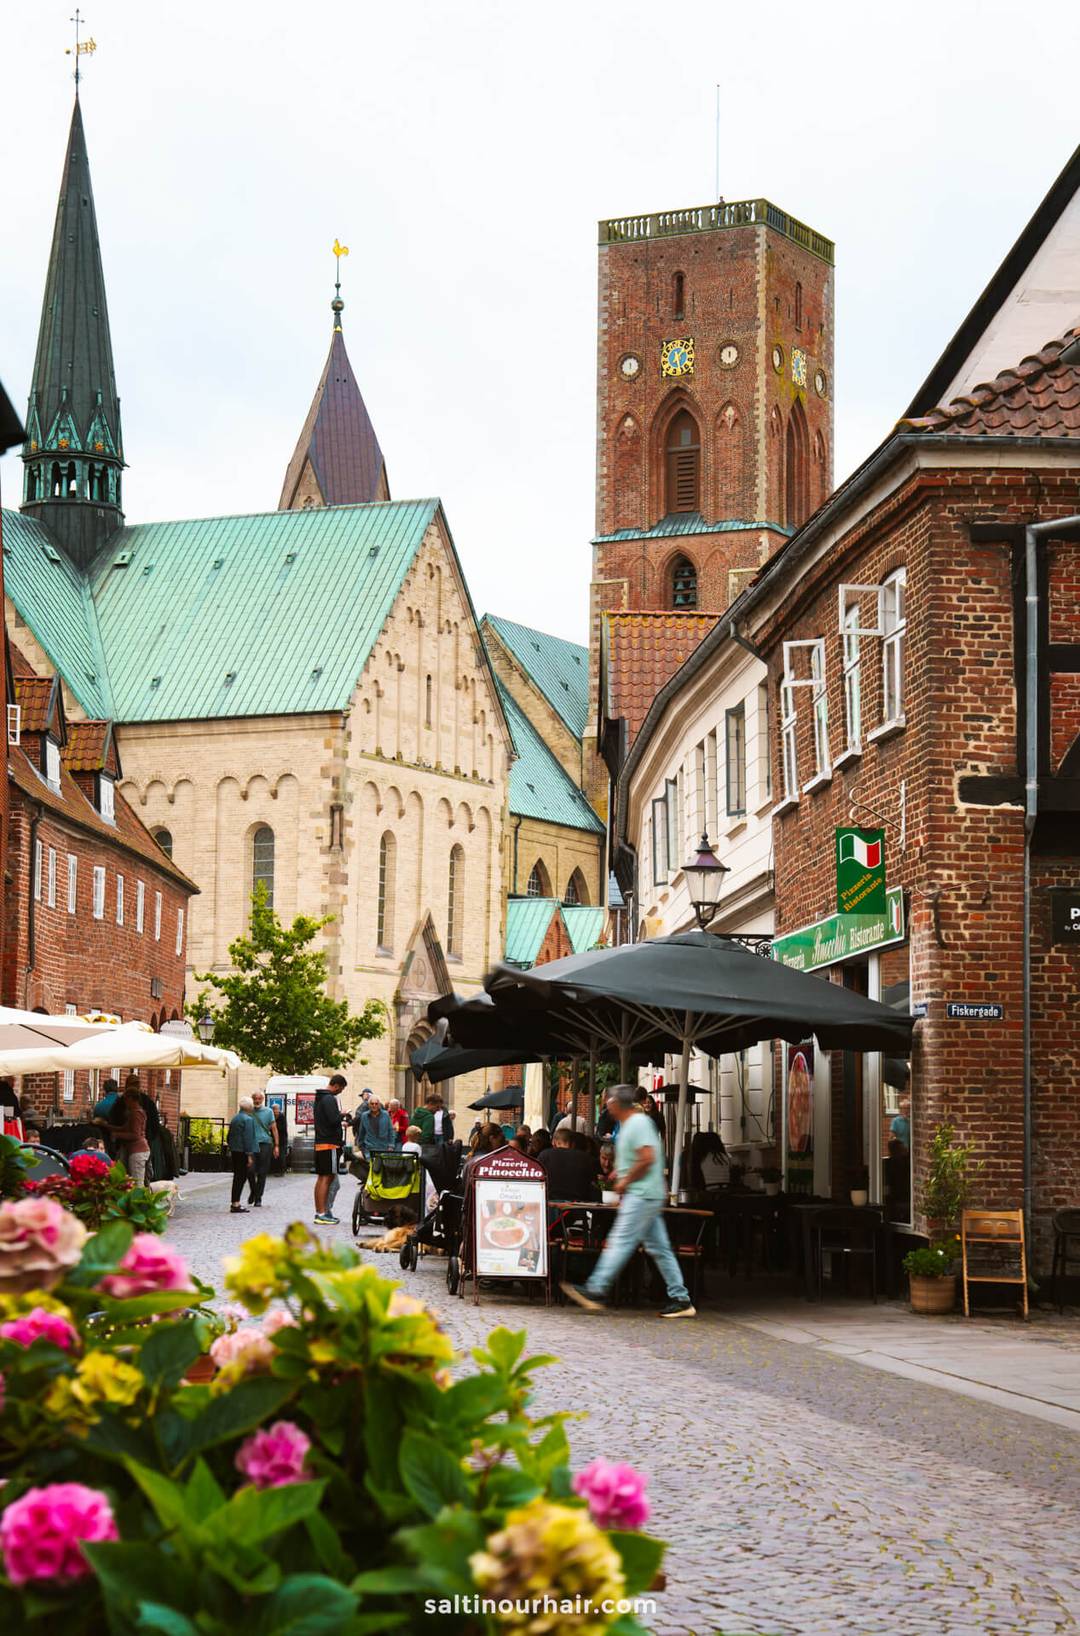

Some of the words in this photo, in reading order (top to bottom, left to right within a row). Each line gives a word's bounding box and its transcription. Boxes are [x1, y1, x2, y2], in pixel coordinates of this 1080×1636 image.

[841, 873, 872, 900] Pizzeria
[844, 878, 882, 912] Ristorante
[849, 920, 885, 951] Ristorante
[951, 1004, 999, 1017] Fiskergade
[478, 1166, 543, 1177] Pinocchio
[492, 1159, 528, 1167] Pizzeria
